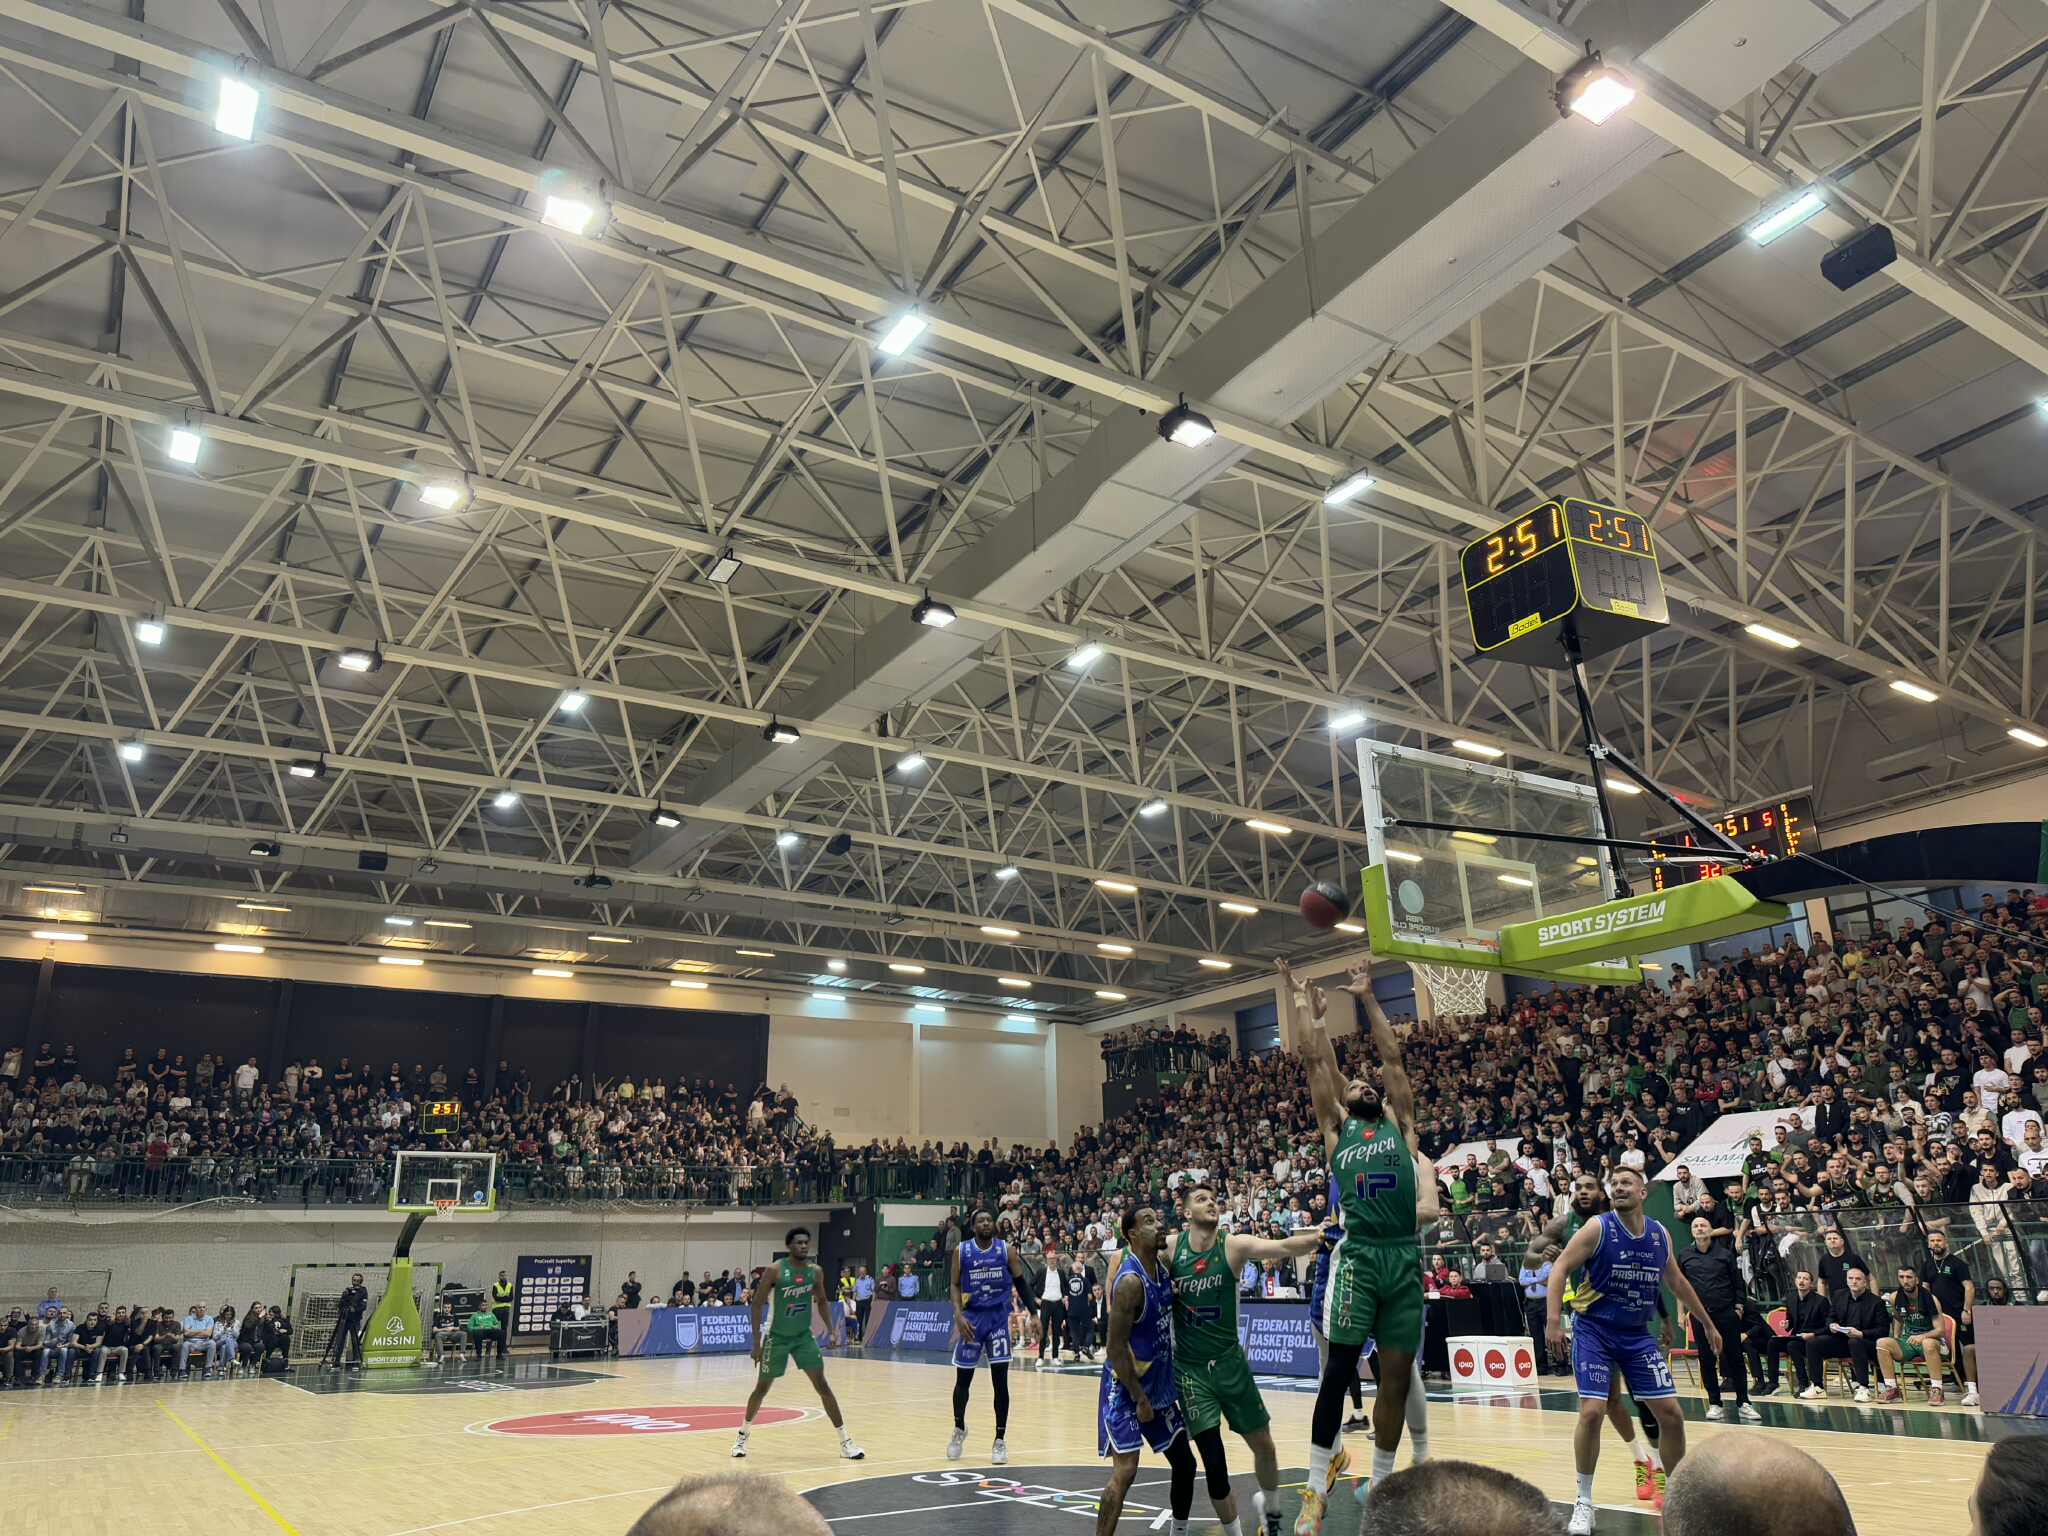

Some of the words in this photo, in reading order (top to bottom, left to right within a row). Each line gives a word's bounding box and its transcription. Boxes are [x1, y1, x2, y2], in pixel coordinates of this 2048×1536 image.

[1588, 510, 1649, 552] 2:51
[1487, 508, 1560, 574] 2:51
[1537, 917, 1593, 942] SPORT
[1595, 900, 1666, 932] SYSTEM
[1383, 1154, 1400, 1167] 32
[1682, 1153, 1745, 1163] SALAMA
[1611, 1269, 1660, 1282] PRISHTINA
[1267, 1281, 1273, 1294] 5
[701, 1314, 749, 1325] FEDERATA
[908, 1311, 935, 1321] FEDERATA
[1251, 1318, 1303, 1332] FEDERATA
[1303, 1320, 1311, 1333] E
[372, 1335, 416, 1346] MISSINI
[1249, 1333, 1317, 1348] BASKETBOLLI
